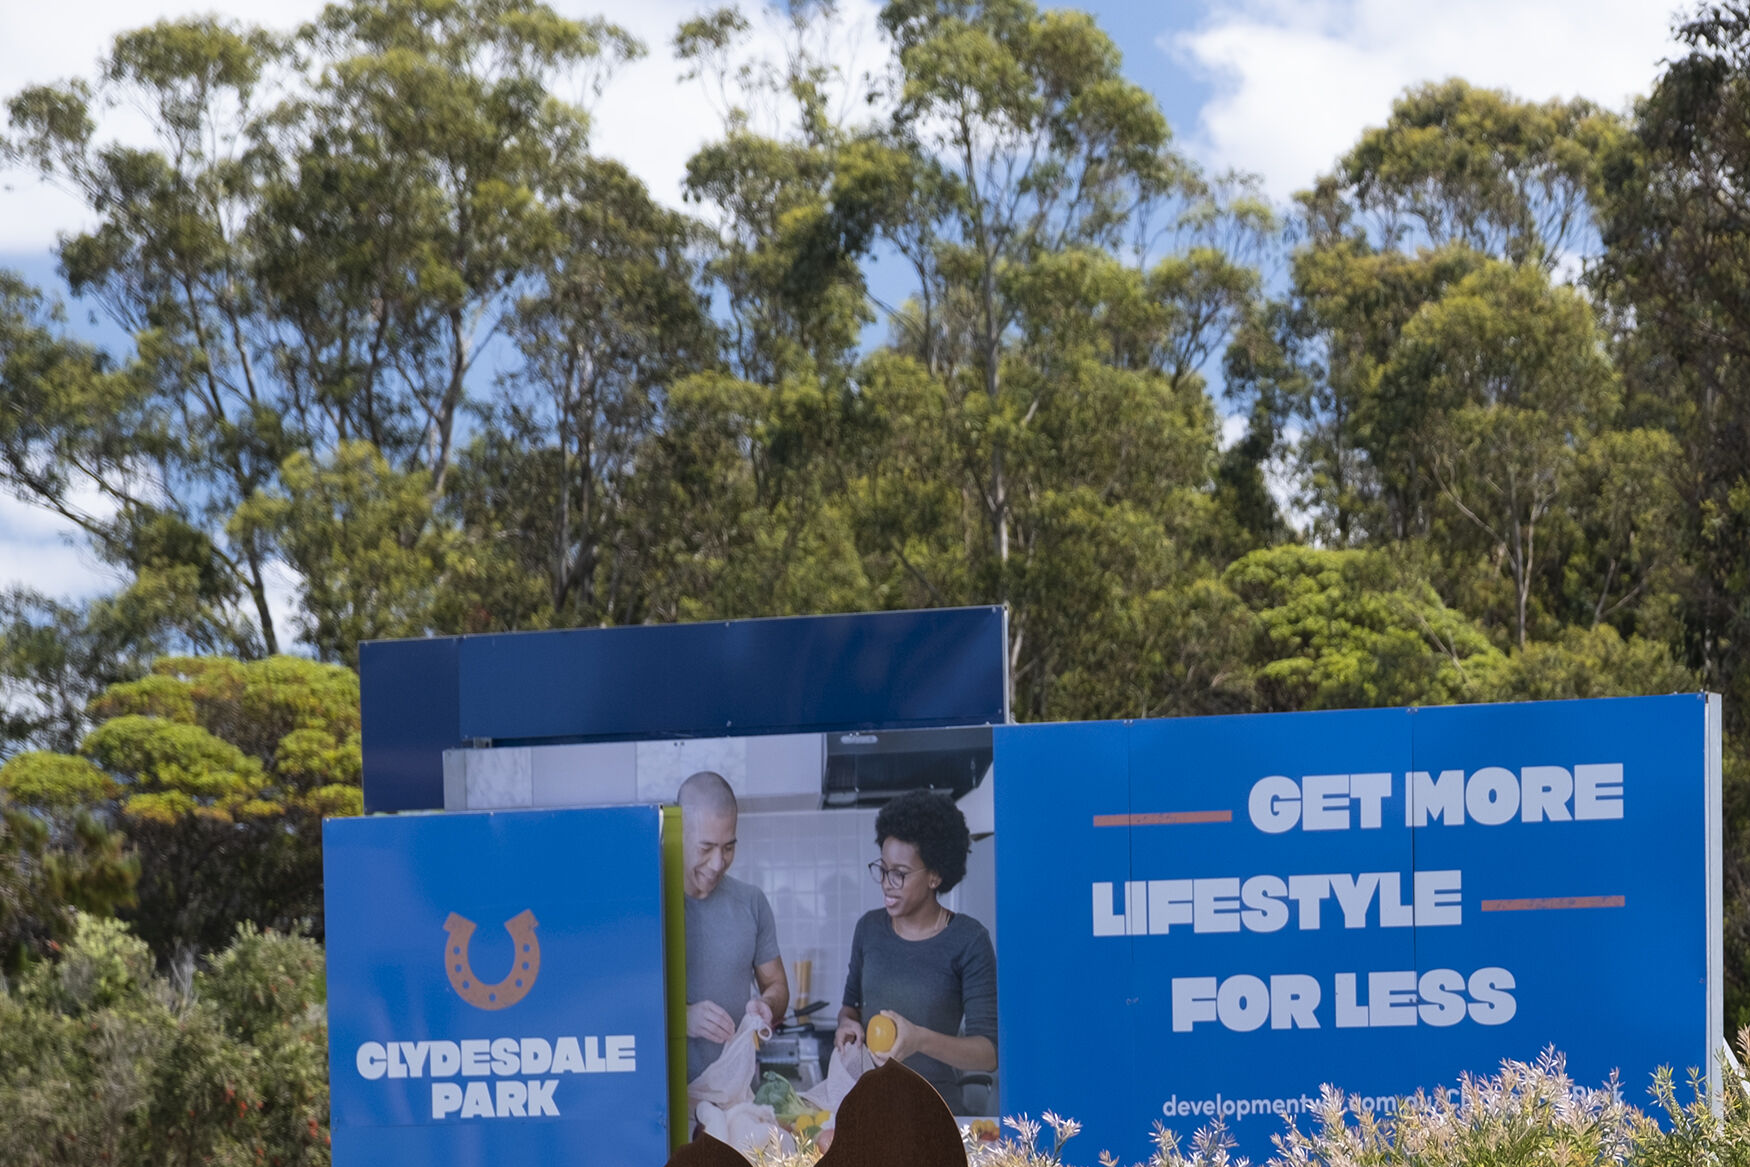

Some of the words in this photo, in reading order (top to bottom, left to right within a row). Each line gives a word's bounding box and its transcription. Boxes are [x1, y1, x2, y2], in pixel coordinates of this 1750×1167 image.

[1248, 772, 1392, 834] GET
[1405, 763, 1624, 827] MORE
[1092, 870, 1462, 937] LIFESTYLE
[1171, 974, 1321, 1032] FOR
[1335, 967, 1517, 1028] LESS
[356, 1035, 636, 1080] CLYDESDALE
[431, 1079, 560, 1119] PARK
